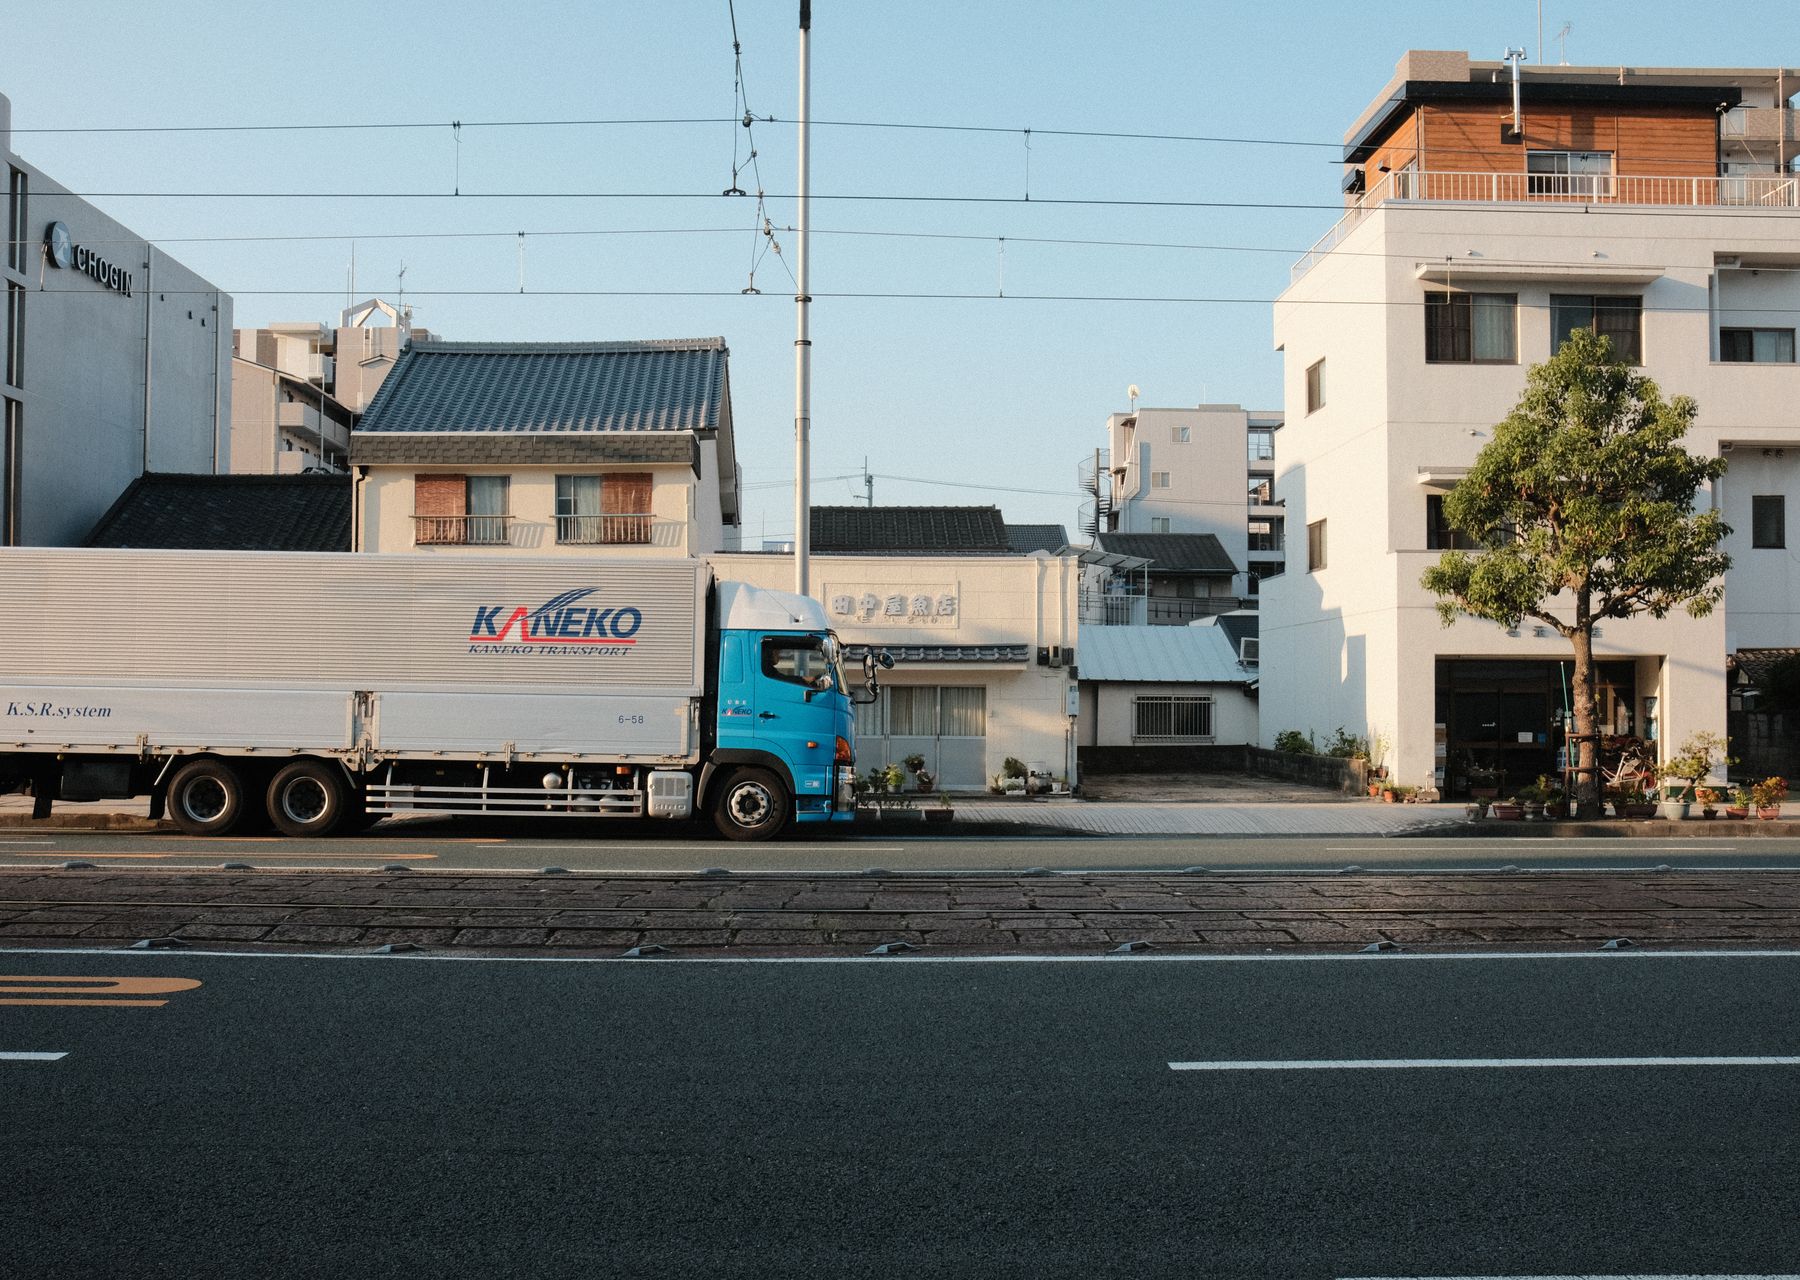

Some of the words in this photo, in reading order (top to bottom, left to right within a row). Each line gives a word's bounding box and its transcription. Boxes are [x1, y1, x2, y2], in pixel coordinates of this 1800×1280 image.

[75, 244, 133, 298] CHOGIN
[471, 605, 643, 640] KANEKO
[468, 645, 534, 655] KANEKO
[538, 645, 632, 656] TRANSPORT
[6, 702, 112, 719] K.S.R.system
[618, 715, 644, 724] 6-58
